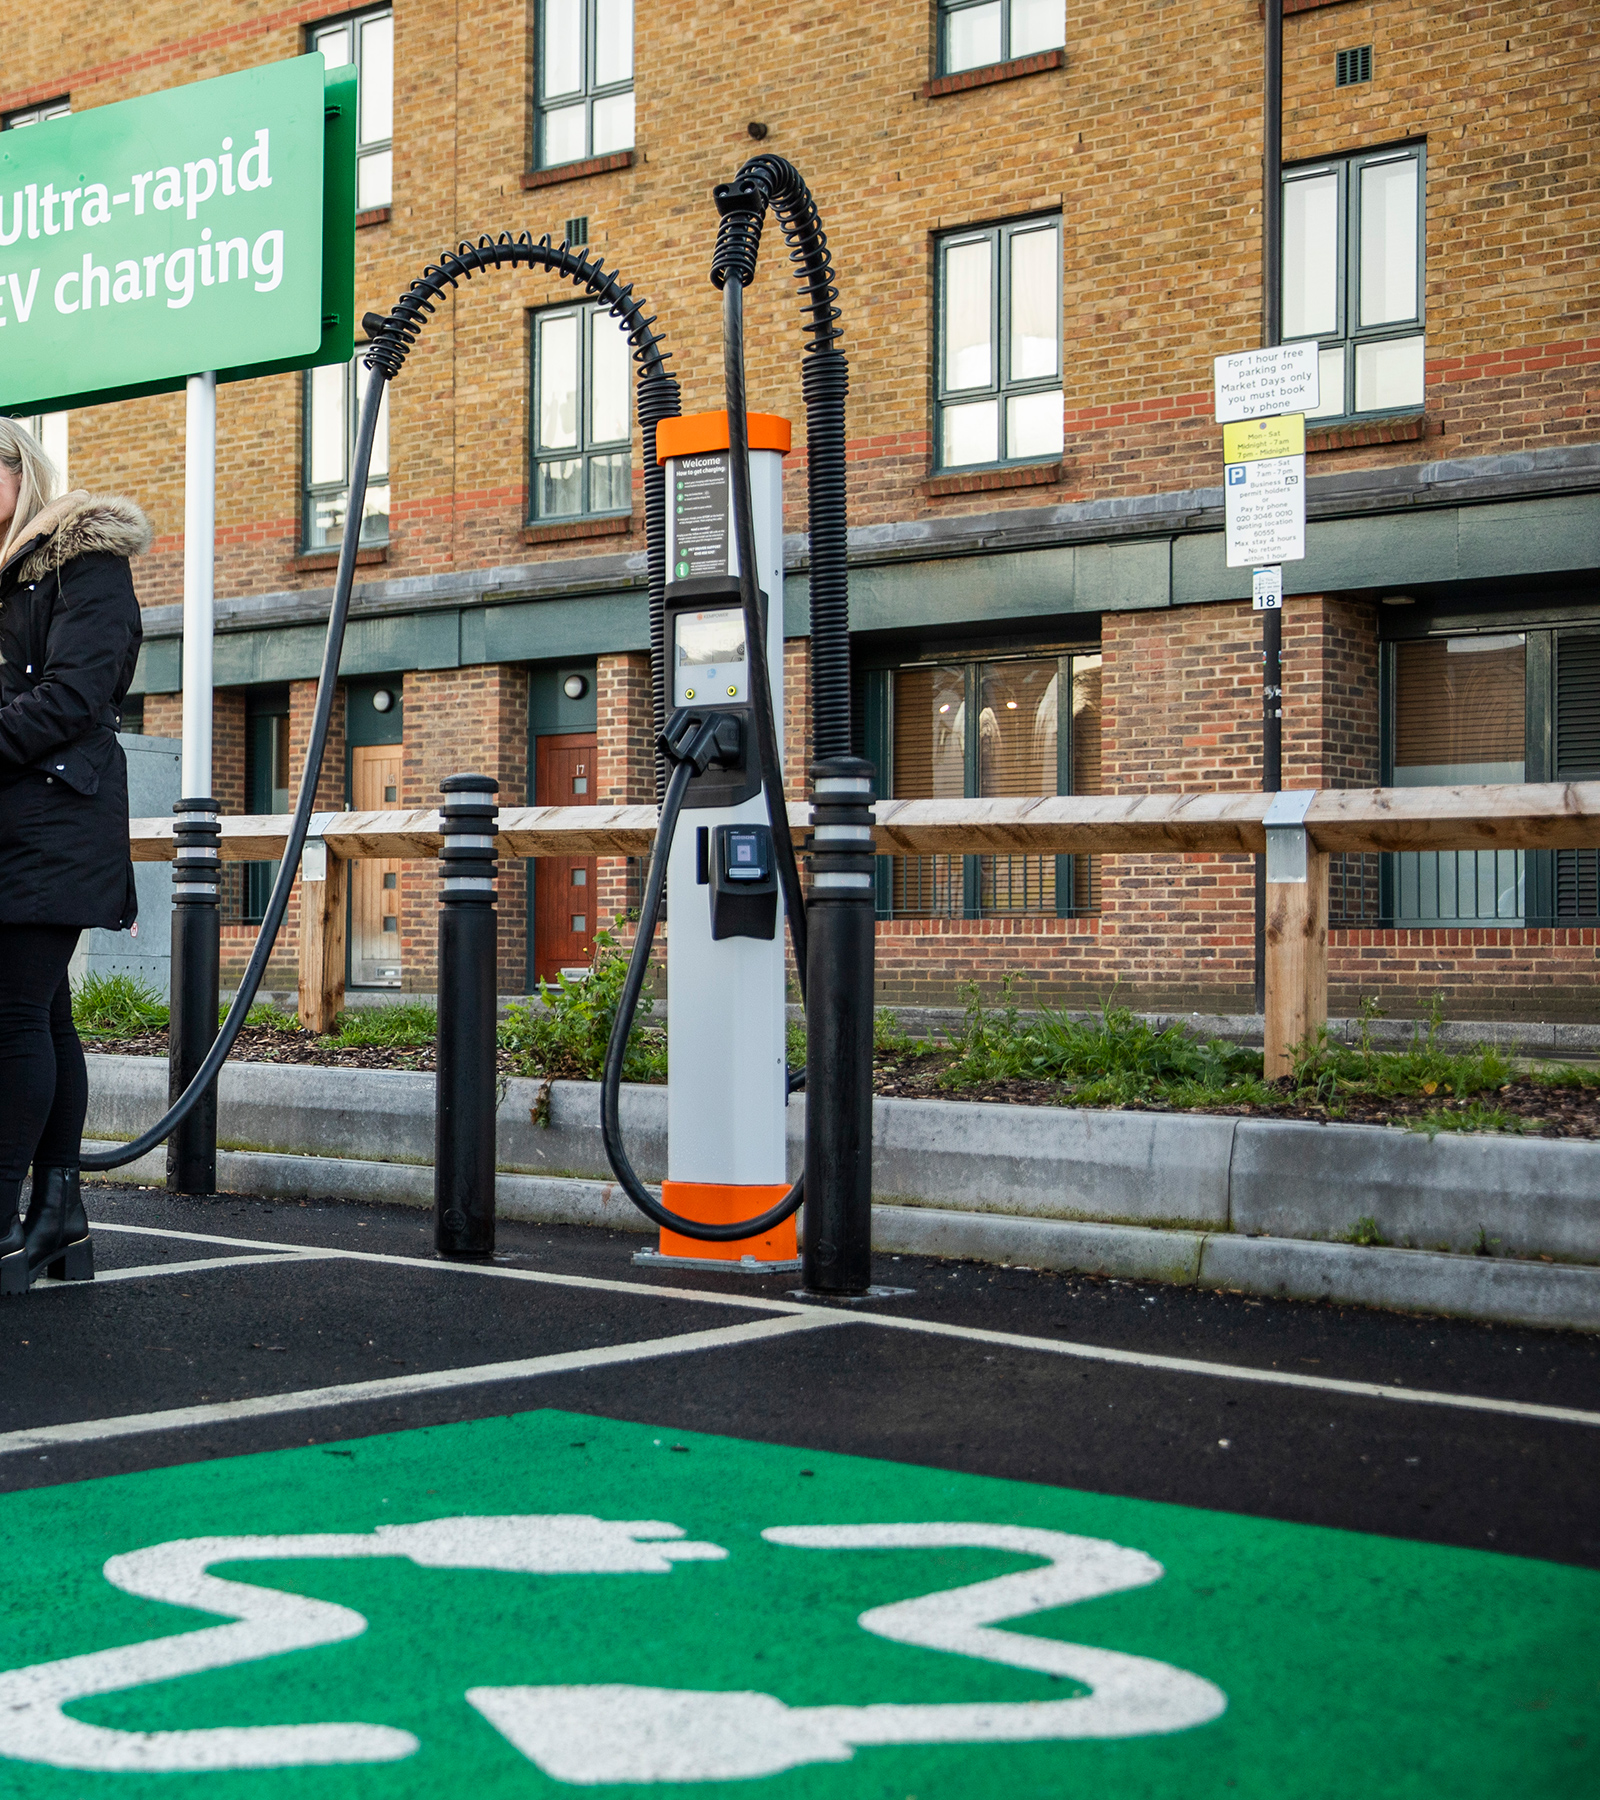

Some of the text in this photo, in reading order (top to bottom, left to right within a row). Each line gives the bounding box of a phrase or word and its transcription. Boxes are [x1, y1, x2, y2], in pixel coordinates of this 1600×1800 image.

[54, 228, 284, 309] charging
[1228, 359, 1244, 369] For
[1256, 353, 1278, 363] hour
[1283, 349, 1304, 359] free
[1239, 365, 1276, 378] parking
[1221, 372, 1312, 393] Market Days only
[1228, 384, 1305, 405] you must book
[1243, 400, 1291, 414] by phone
[1237, 441, 1267, 450] Midnight
[1260, 446, 1290, 456] Midnight
[682, 457, 721, 469] Welcome
[694, 468, 702, 476] get
[1231, 468, 1244, 484] P
[1250, 480, 1281, 489] Business
[1240, 490, 1262, 499] permit
[1267, 502, 1288, 510] phone
[1236, 518, 1293, 531] quoting location
[1258, 594, 1275, 607] 18
[576, 764, 585, 776] 17
